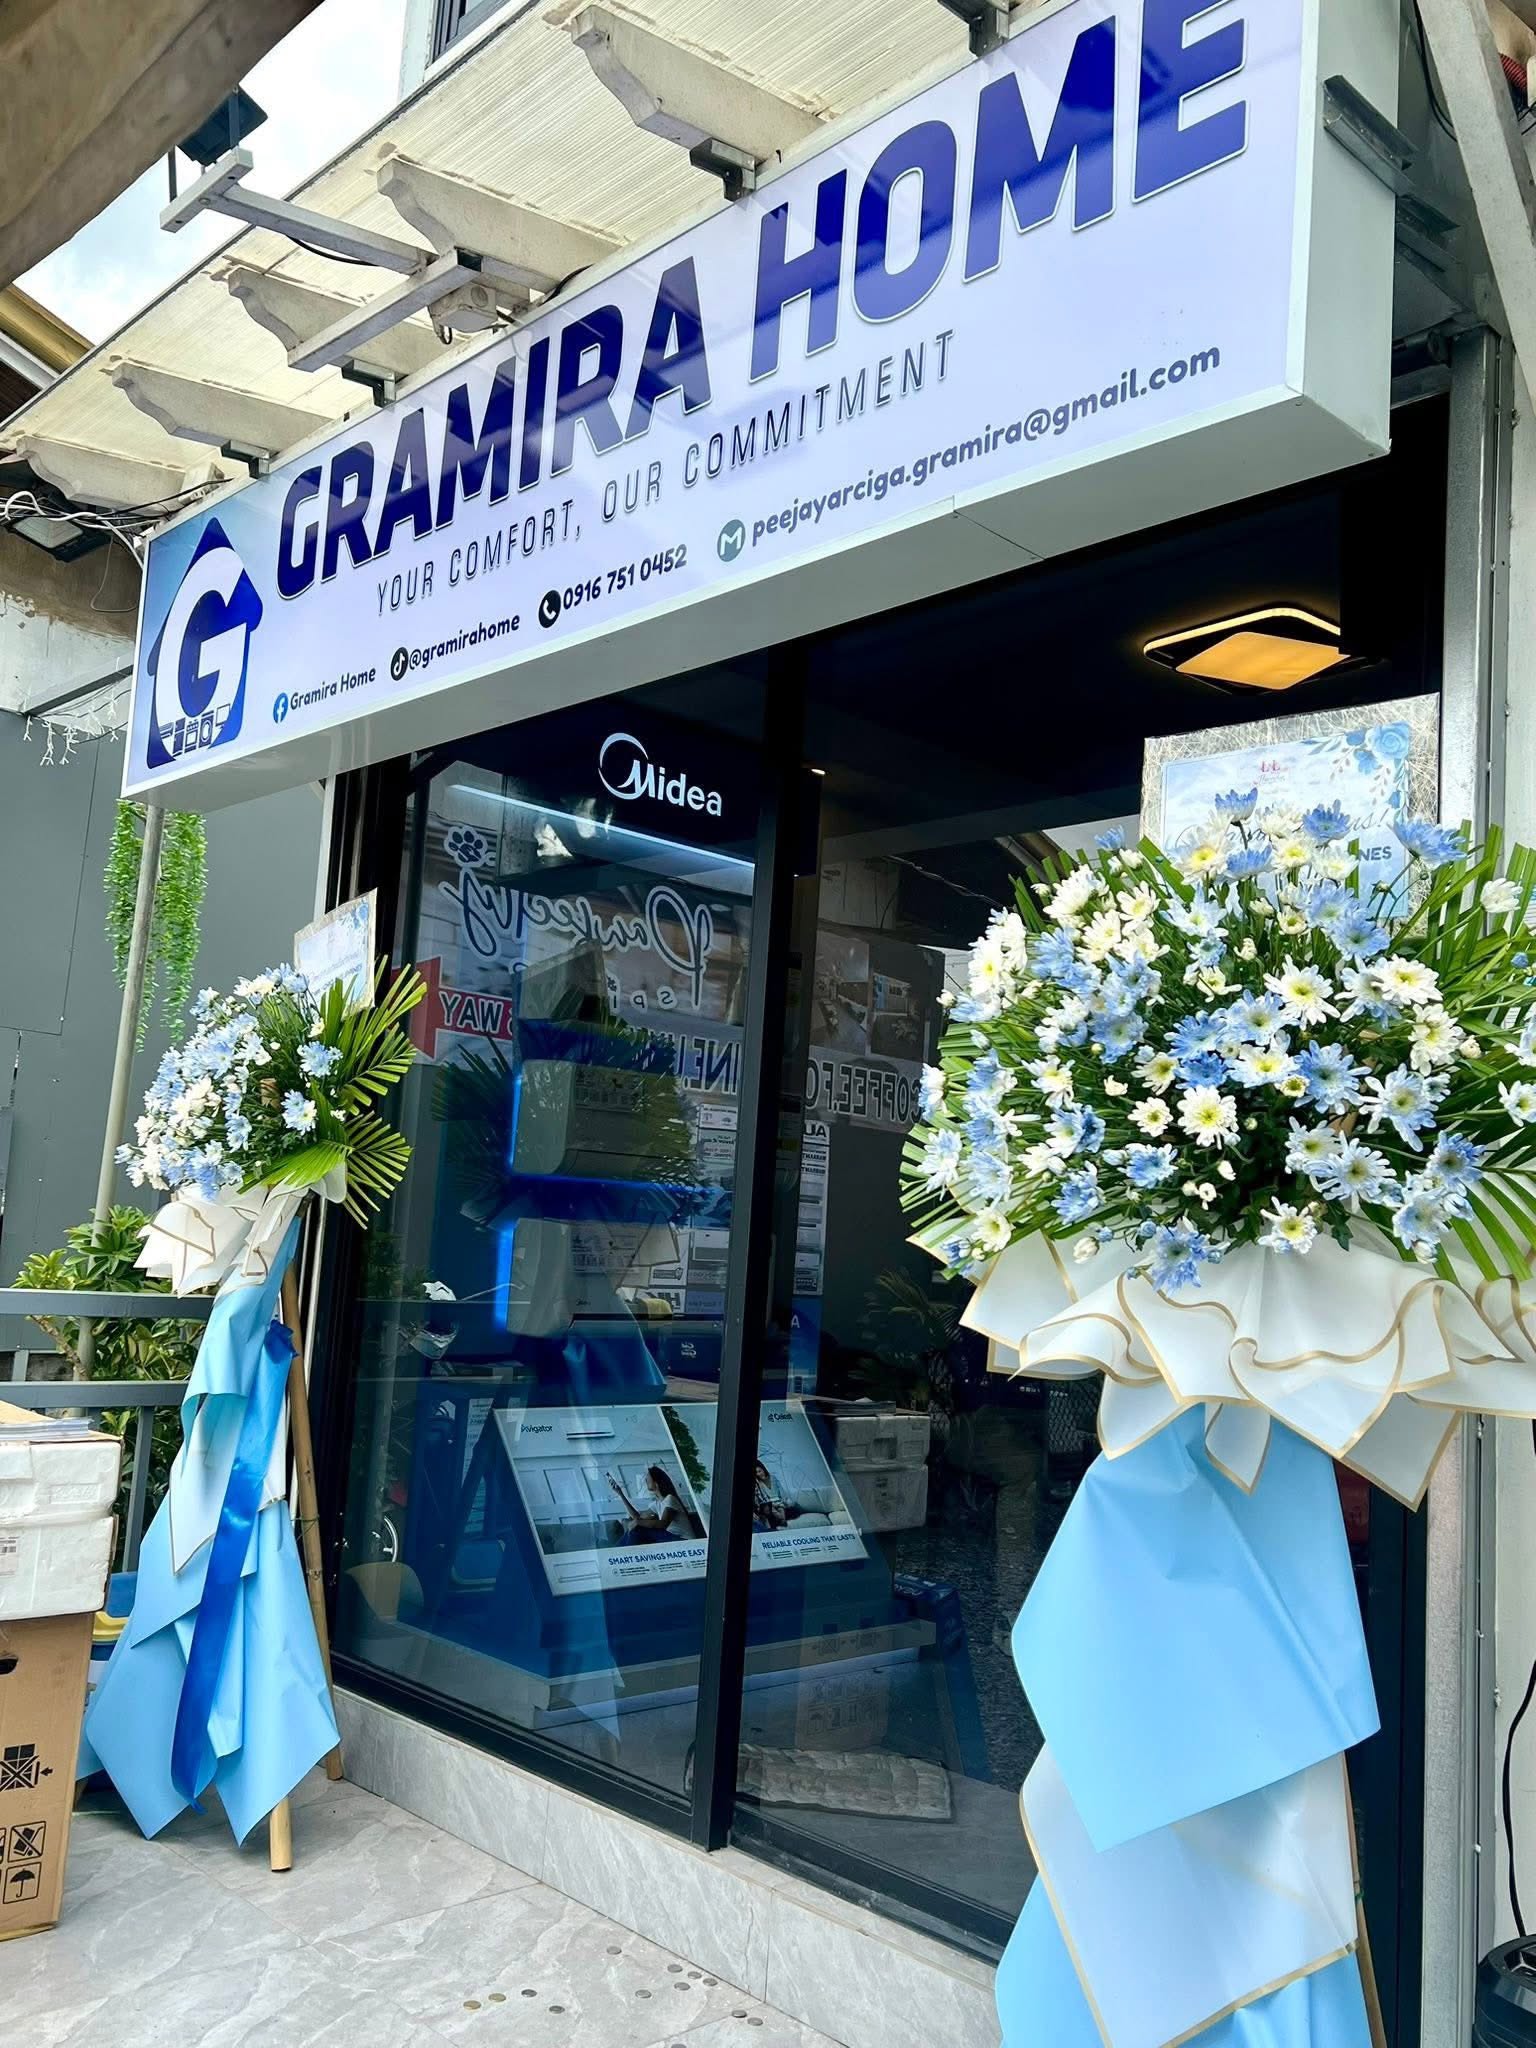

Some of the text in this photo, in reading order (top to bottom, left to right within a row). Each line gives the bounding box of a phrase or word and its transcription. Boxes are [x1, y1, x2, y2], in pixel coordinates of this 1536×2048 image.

[277, 0, 1247, 600] GRAMIRA HOME
[376, 329, 955, 615] YOUR COMFORT, OUR COMMITMENT
[752, 345, 1221, 547] peejayarciga.gramira@gmail.com
[564, 544, 687, 610] 0916 751 0452
[409, 614, 520, 671] @gramirahome
[290, 681, 337, 710] Gramira
[340, 667, 376, 693] Home
[598, 733, 722, 816] Midea
[608, 1548, 706, 1566] SMART SAVINGS MADE EASY
[762, 1533, 855, 1550] RELIABLE COOLING THAT LASTS
